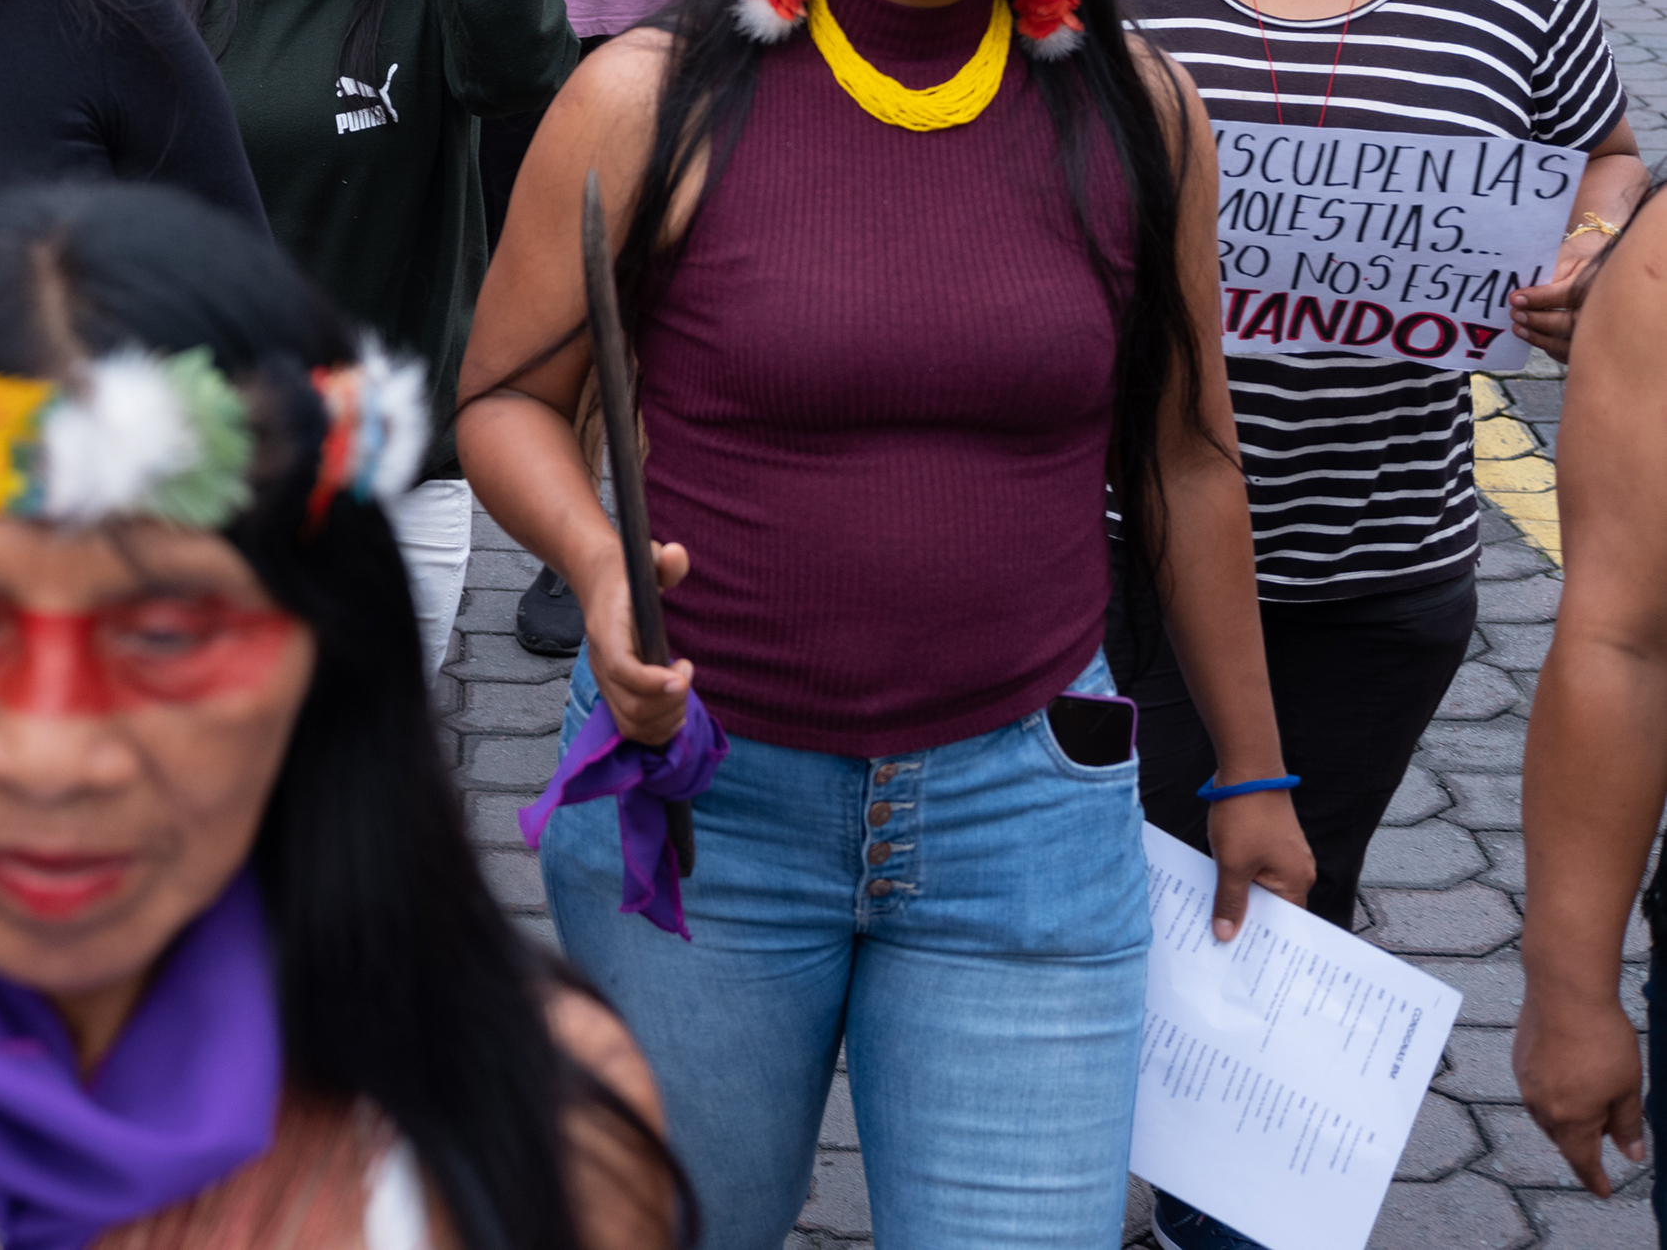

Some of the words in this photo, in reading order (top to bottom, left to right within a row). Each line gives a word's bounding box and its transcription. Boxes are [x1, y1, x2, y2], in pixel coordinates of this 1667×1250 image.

[335, 105, 387, 135] PUMA
[1471, 141, 1569, 206] LAS
[1292, 252, 1394, 295] NOS
